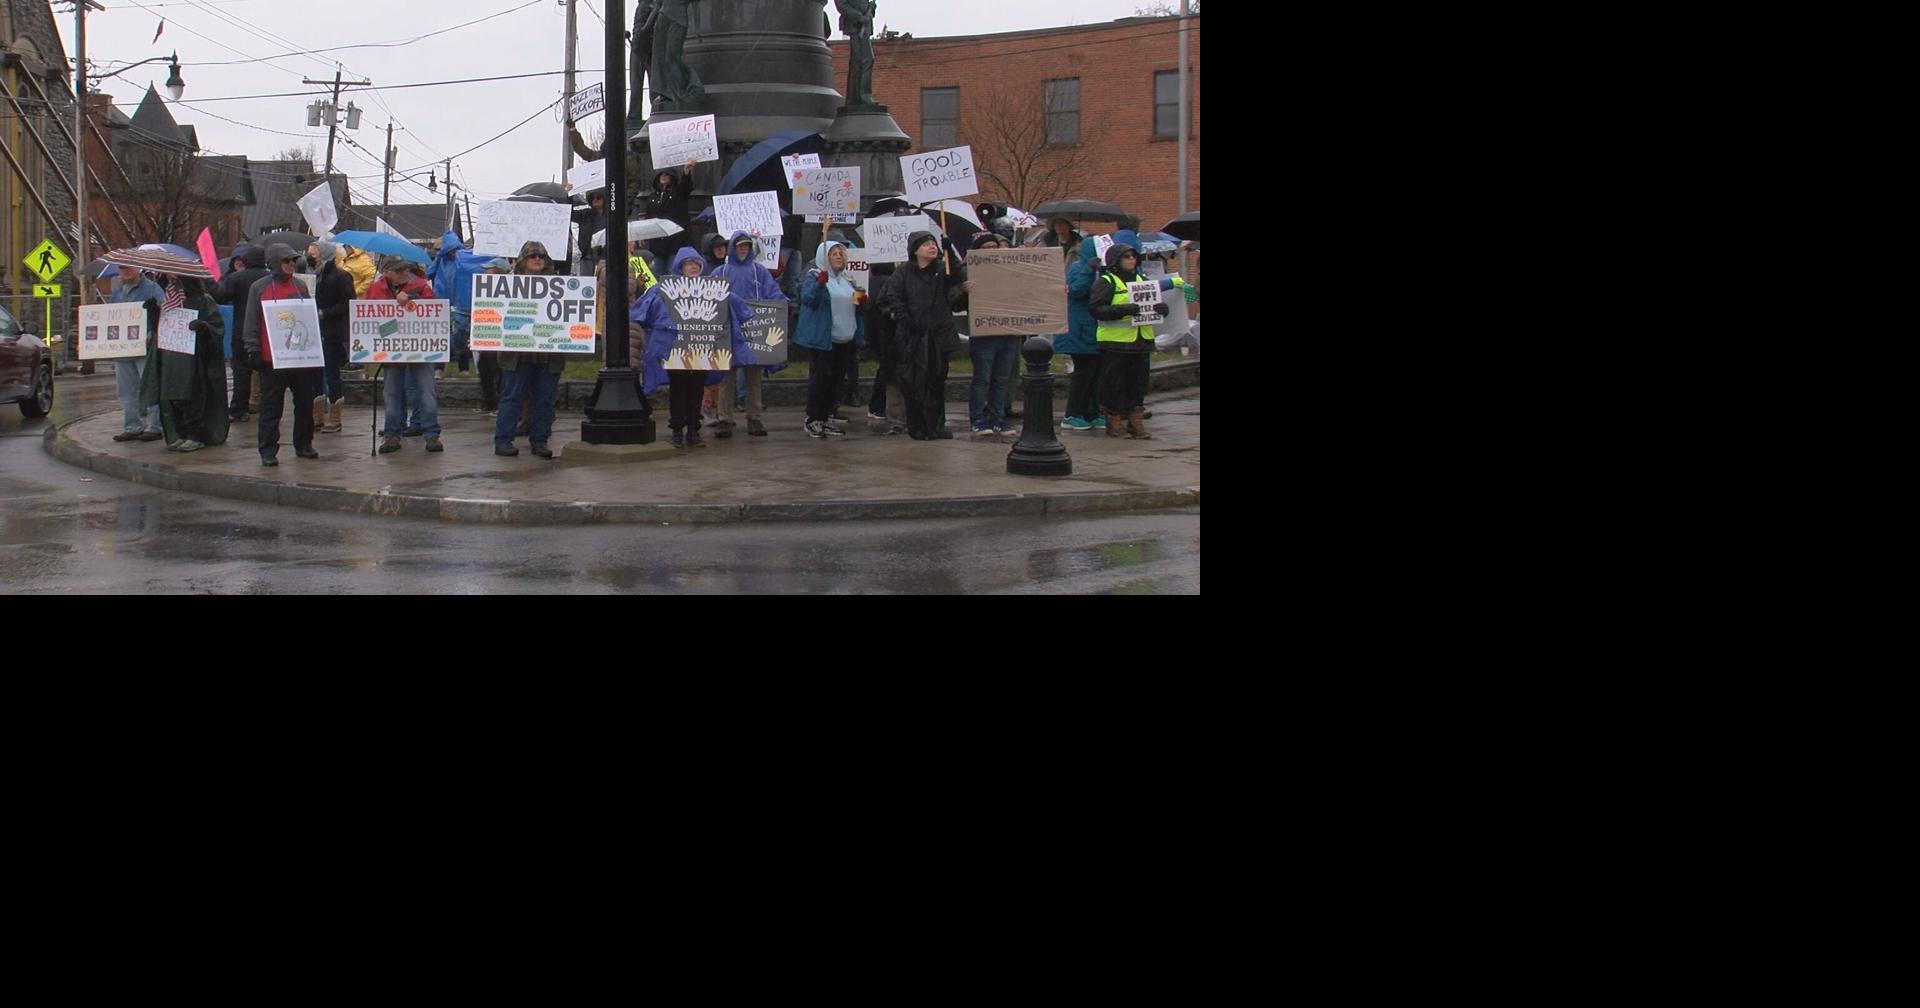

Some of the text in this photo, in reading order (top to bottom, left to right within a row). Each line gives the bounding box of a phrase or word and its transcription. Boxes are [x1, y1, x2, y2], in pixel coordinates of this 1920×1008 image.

[687, 120, 712, 132] OFF
[911, 151, 962, 177] GOOD
[806, 170, 850, 185] CANADA
[912, 167, 972, 192] TROUBLE
[740, 192, 774, 202] POWER
[809, 188, 856, 201] NOT FOR
[816, 200, 844, 210] SALE
[872, 222, 908, 238] HANDS
[890, 232, 909, 244] OFF
[1032, 253, 1048, 264] OUT
[475, 275, 566, 299] HANDS
[668, 286, 722, 298] HANDS
[1131, 283, 1156, 291] HANDS
[1133, 291, 1157, 302] OFF!
[108, 309, 122, 321] NO
[129, 308, 144, 321] NO
[356, 304, 443, 318] HANDS OFF
[546, 299, 595, 322] OFF
[683, 309, 713, 318] OFF!
[1133, 313, 1162, 323] SERVICES
[352, 321, 449, 335] OUR RIGHTS
[351, 338, 449, 352] & FREEDOMS
[746, 342, 773, 353] URES
